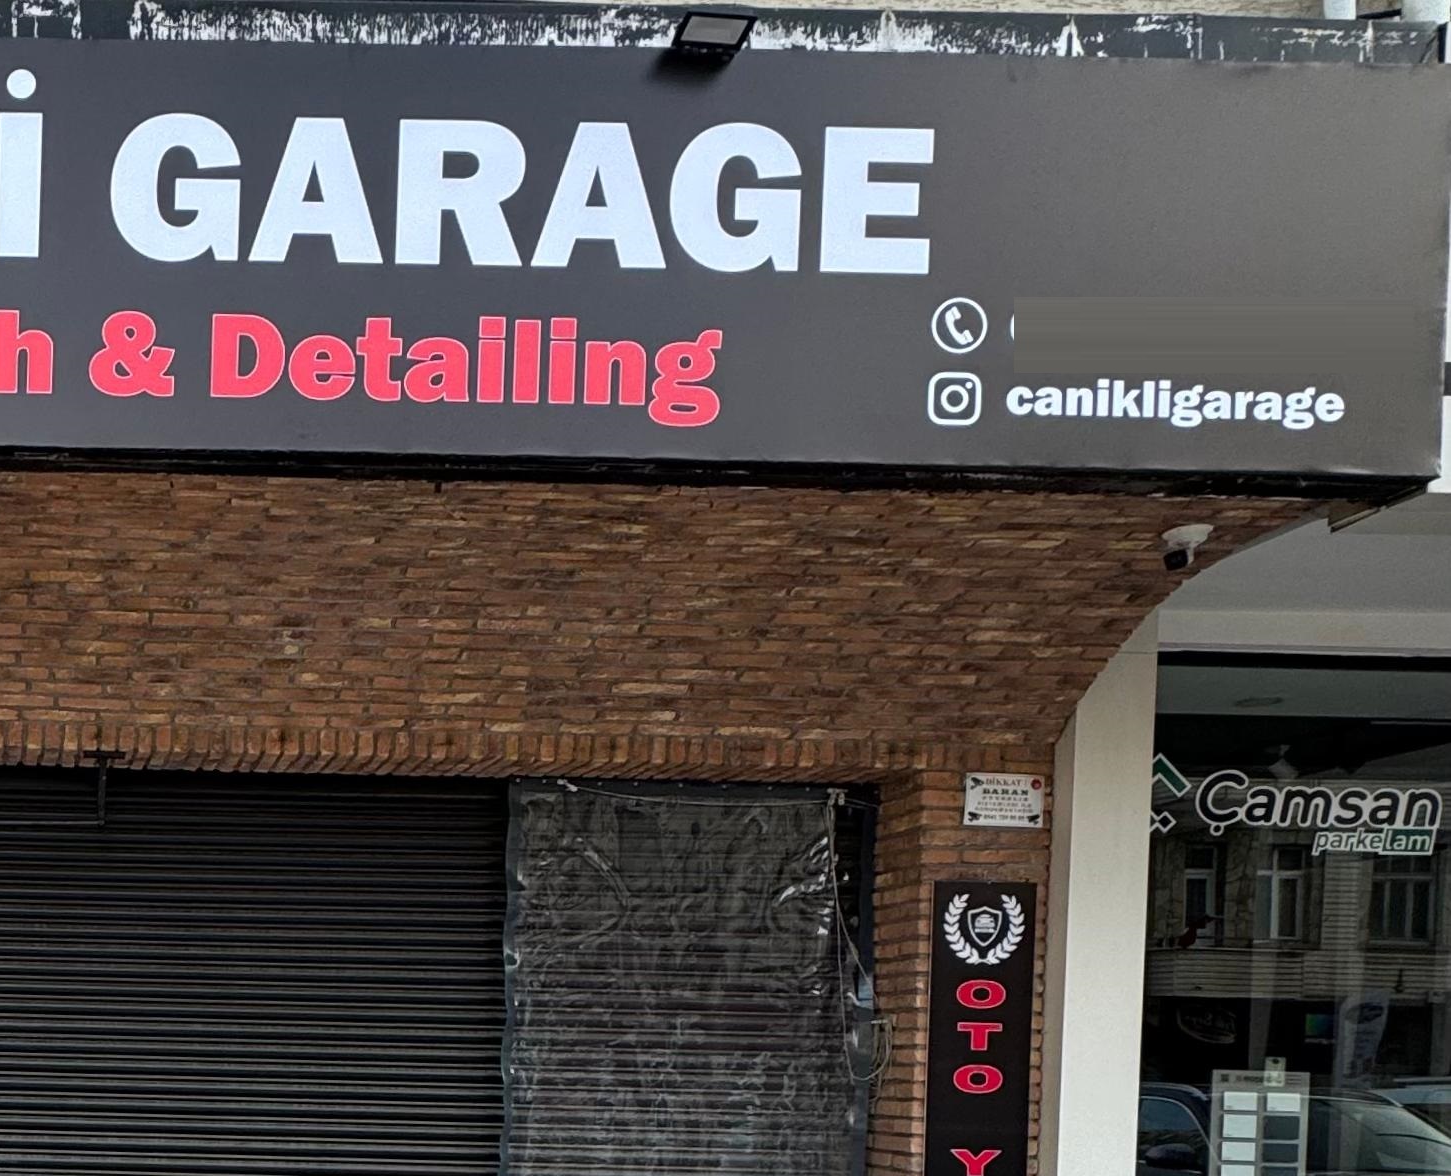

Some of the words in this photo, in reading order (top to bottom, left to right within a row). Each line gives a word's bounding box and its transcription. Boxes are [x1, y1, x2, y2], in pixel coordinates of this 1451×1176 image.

[110, 112, 935, 275] GARAGE
[88, 311, 176, 398] &
[209, 313, 723, 428] Detailing
[1005, 378, 1346, 431] canikligarage
[1195, 769, 1442, 836] Çamsan
[1312, 828, 1433, 855] parkelam
[953, 979, 1006, 1094] OTO
